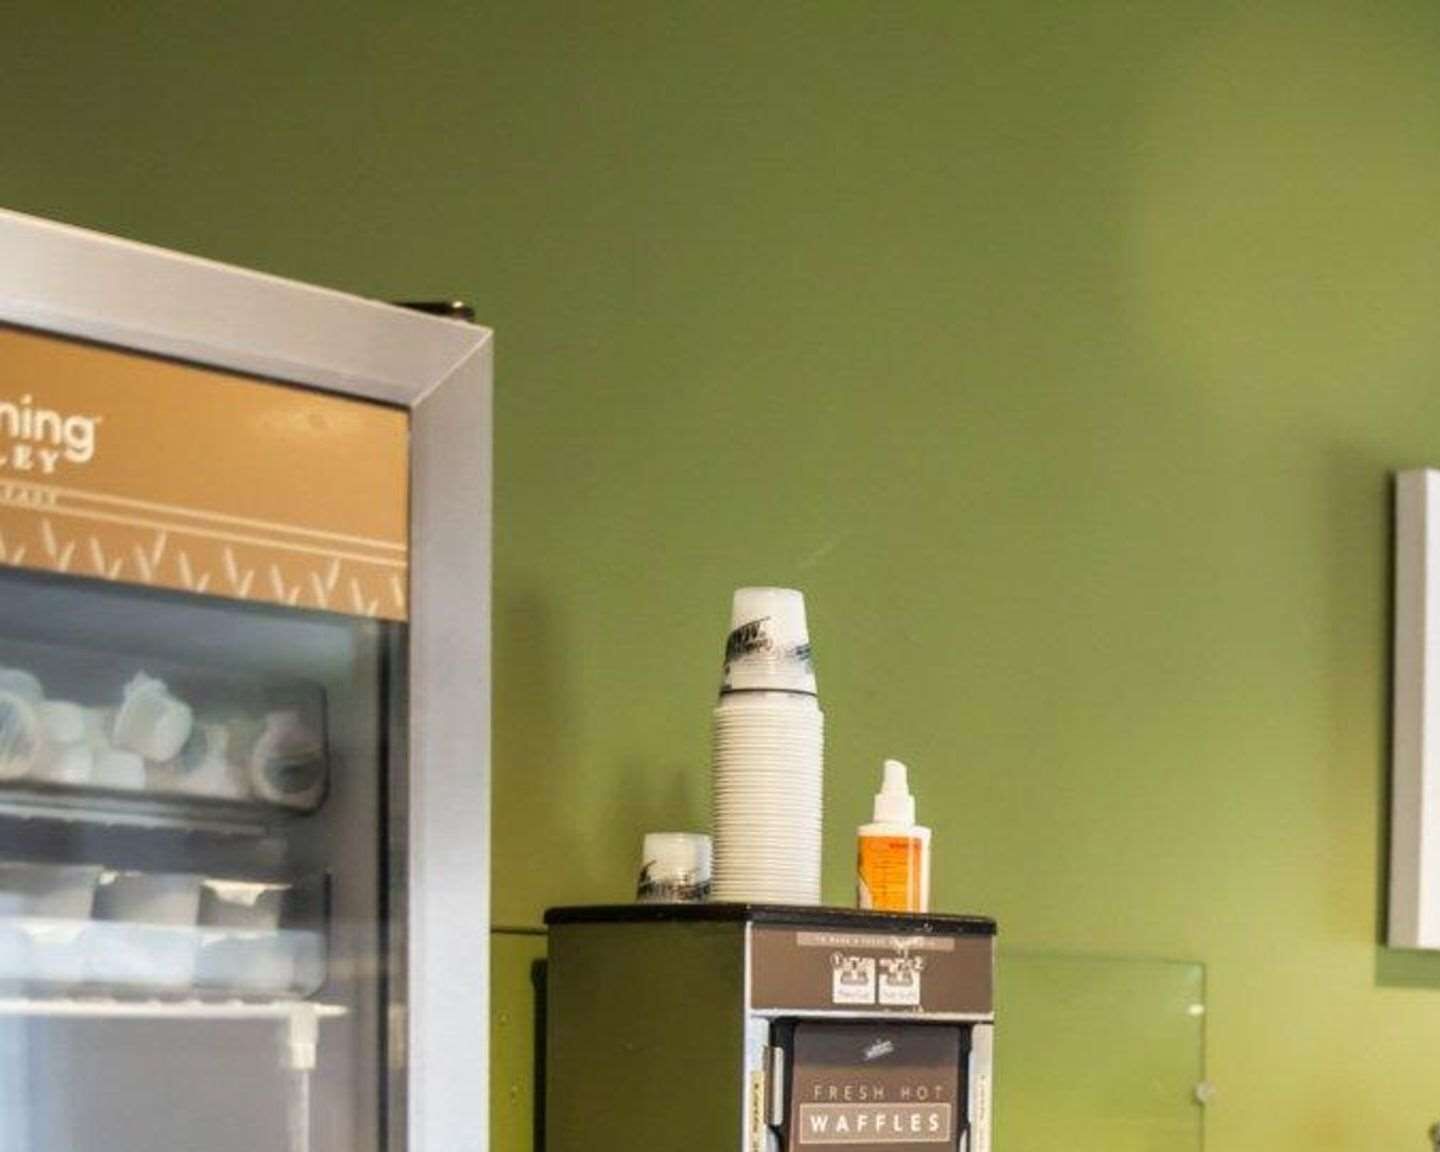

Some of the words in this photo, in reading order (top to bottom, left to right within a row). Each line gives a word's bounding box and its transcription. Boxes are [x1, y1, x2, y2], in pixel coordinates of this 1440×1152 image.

[0, 443, 59, 475] EY
[813, 1084, 885, 1101] FRESH
[901, 1085, 944, 1101] HOT
[809, 1113, 940, 1133] WAFFLES
